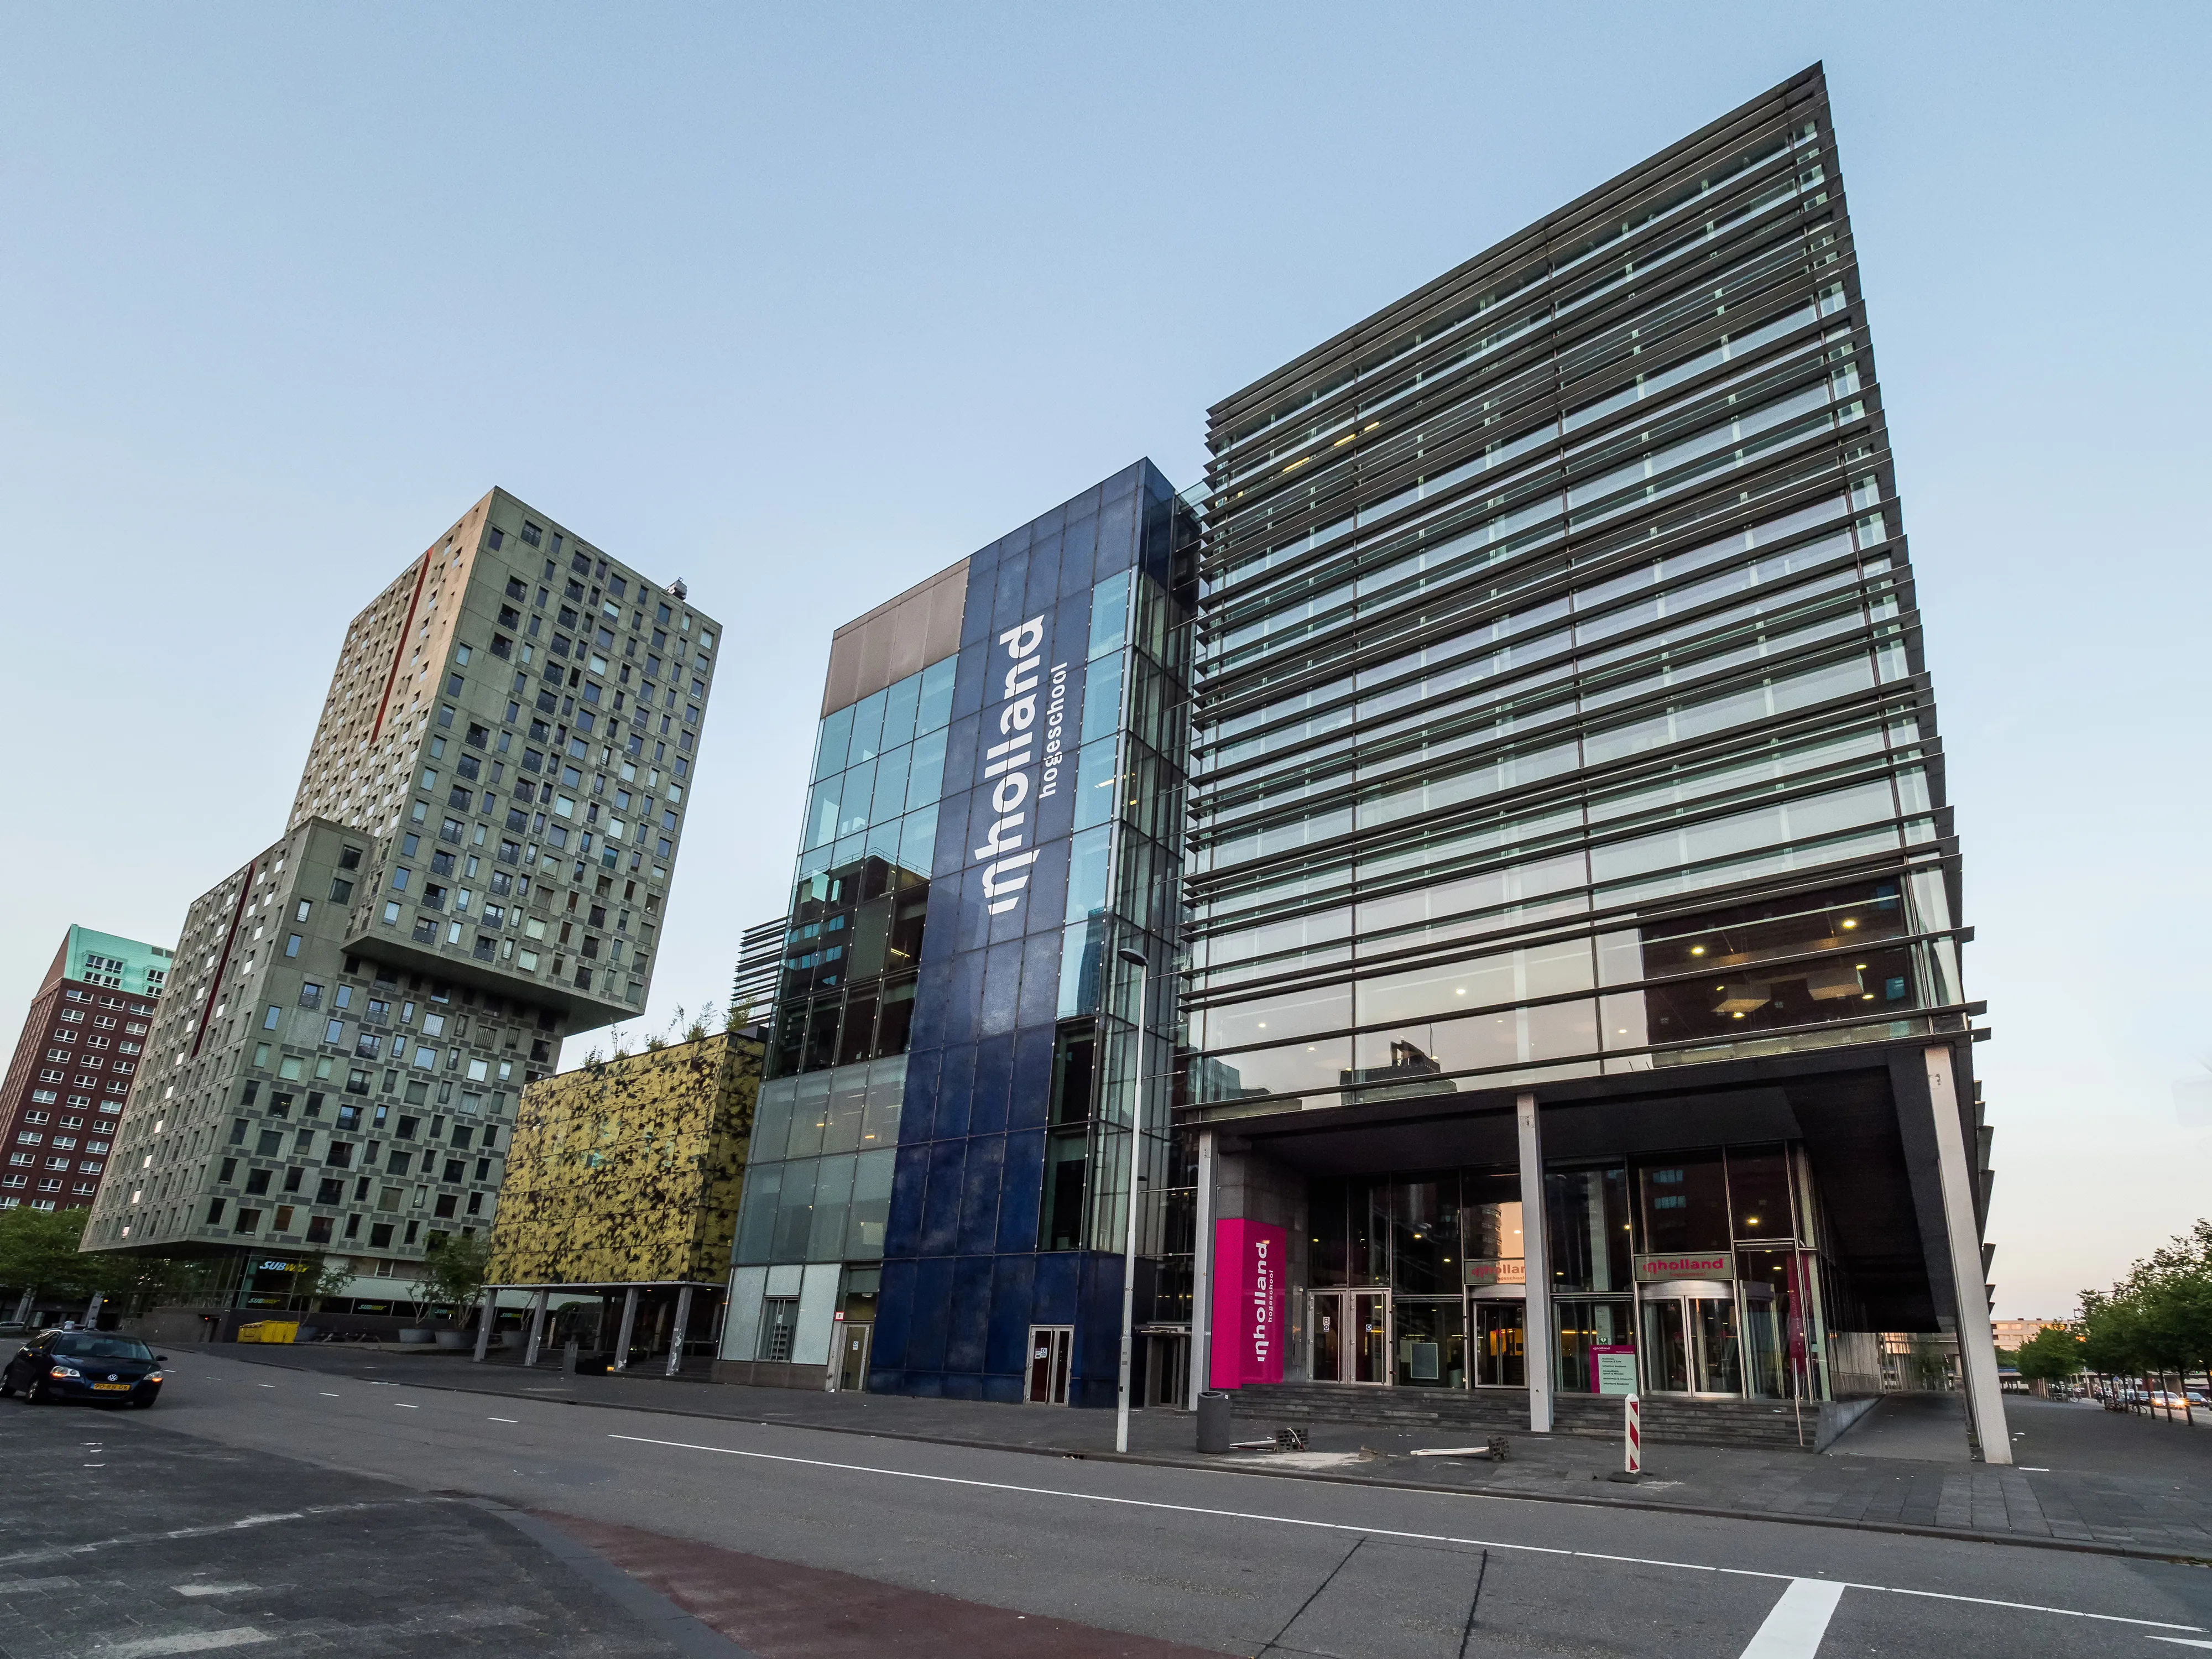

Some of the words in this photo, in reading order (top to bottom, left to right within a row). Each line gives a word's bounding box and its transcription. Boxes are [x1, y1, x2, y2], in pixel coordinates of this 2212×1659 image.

[974, 614, 1045, 915] inholland
[1039, 662, 1068, 799] hogeschool
[1253, 1242, 1270, 1361] inholland
[1642, 1258, 1724, 1274] inholland
